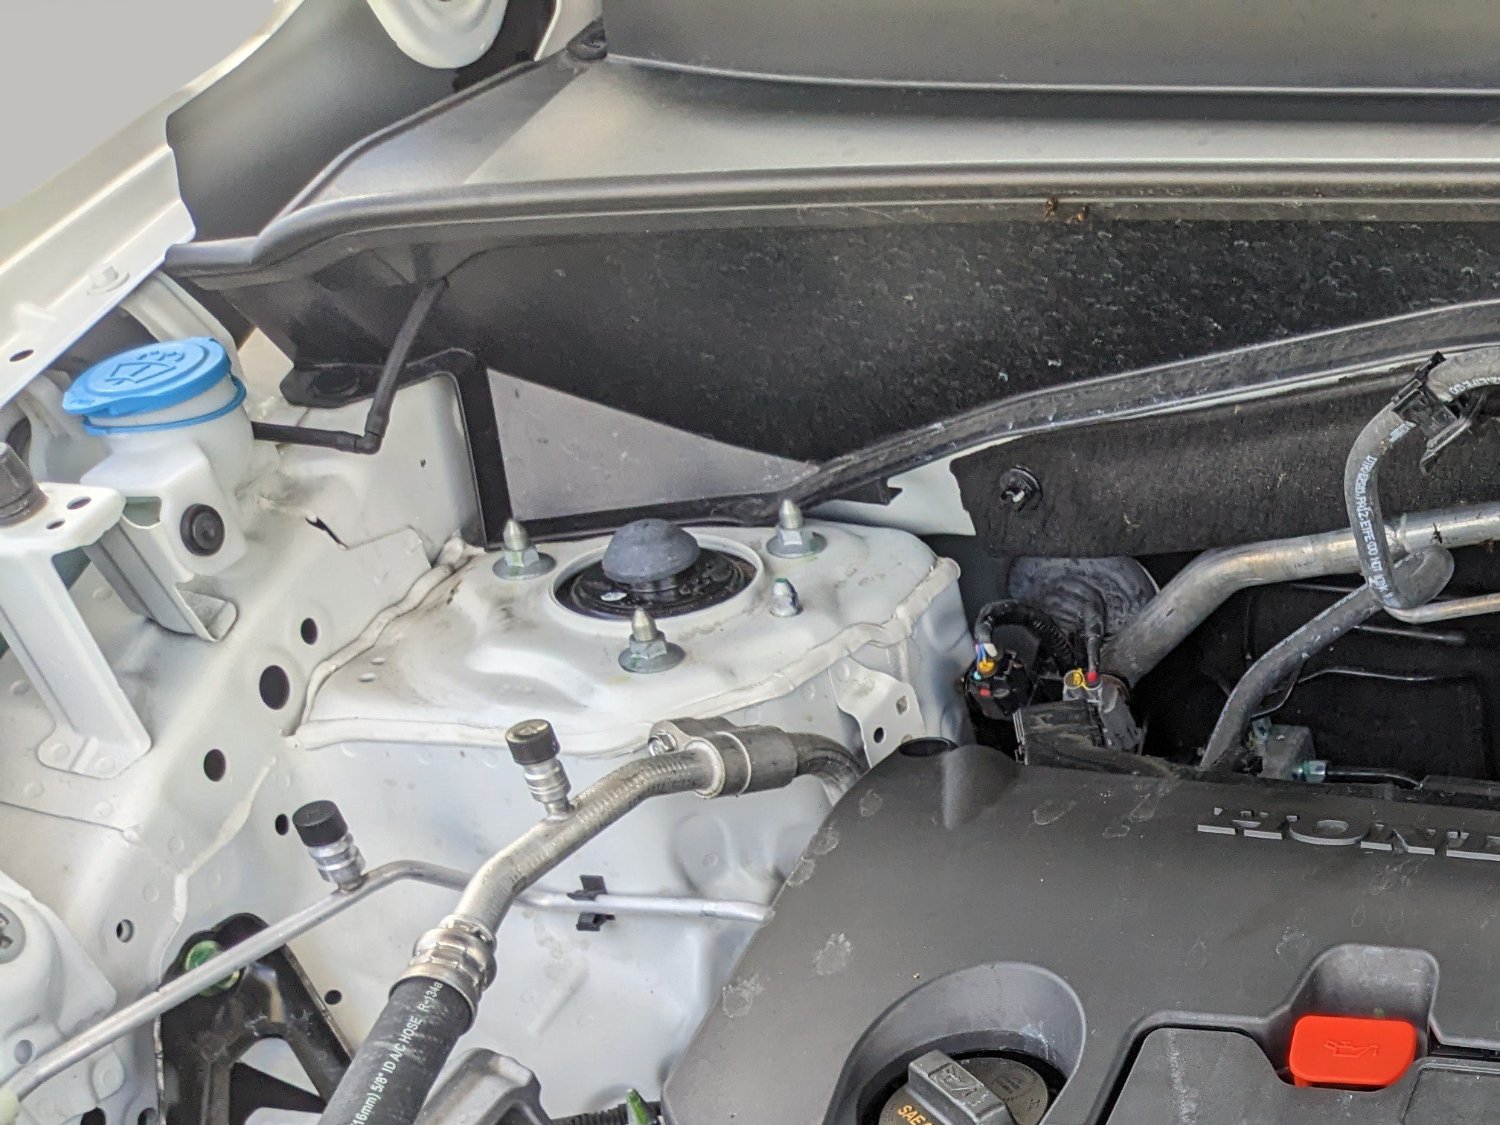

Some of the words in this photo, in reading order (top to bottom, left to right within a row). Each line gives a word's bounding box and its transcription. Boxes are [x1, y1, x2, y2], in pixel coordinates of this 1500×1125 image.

[382, 1060, 397, 1075] ID
[390, 1042, 406, 1062] A/C
[400, 1015, 422, 1044] HOSE
[419, 981, 443, 1013] R-134a
